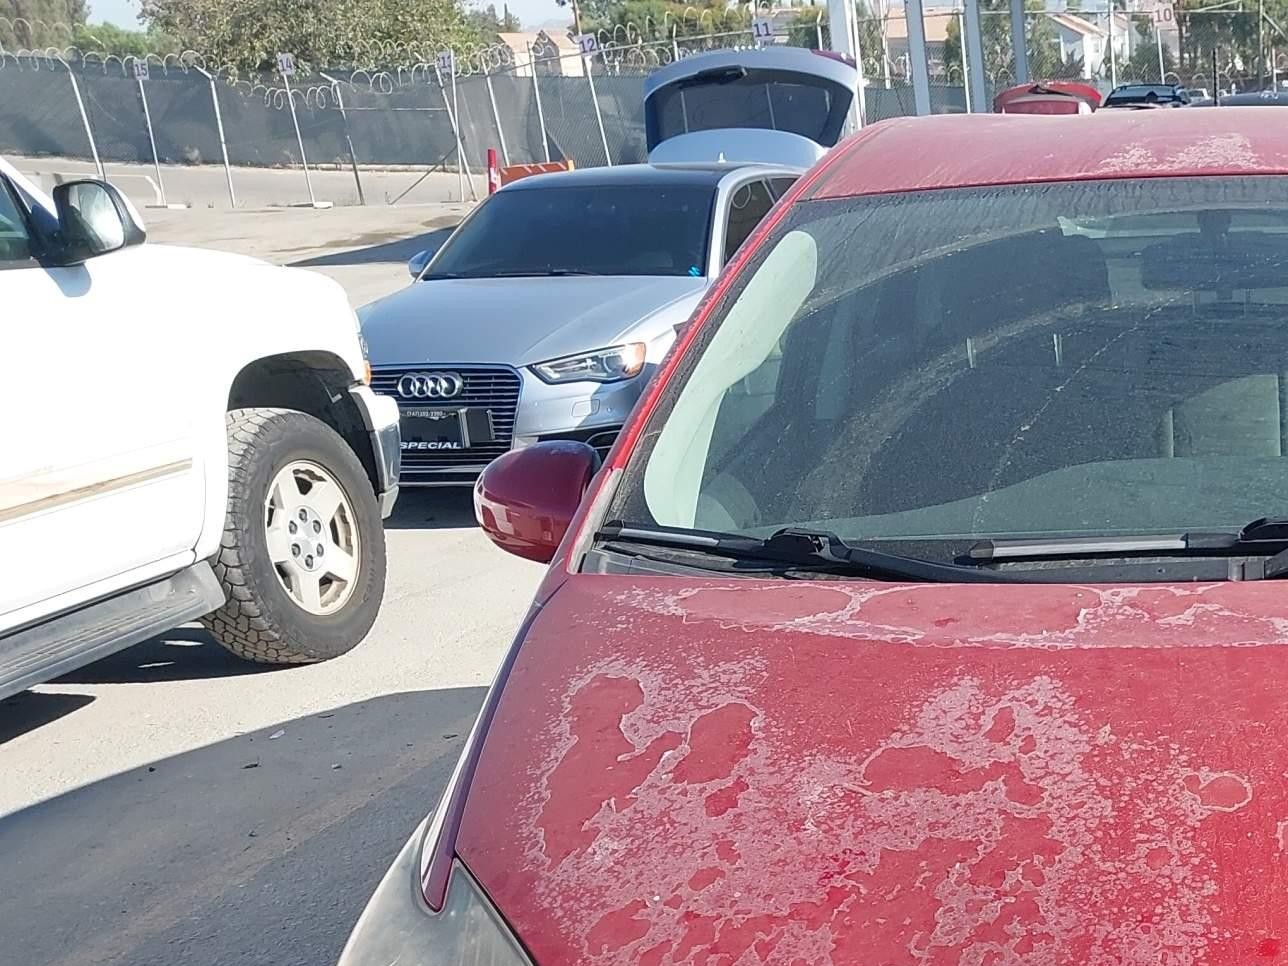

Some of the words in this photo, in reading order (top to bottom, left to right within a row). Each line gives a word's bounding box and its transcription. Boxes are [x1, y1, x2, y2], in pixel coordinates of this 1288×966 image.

[1153, 8, 1172, 23] 10
[753, 22, 771, 38] 11
[579, 37, 597, 54] 12
[134, 63, 148, 77] 15
[279, 57, 293, 72] 14
[400, 441, 462, 450] SPECIAL
